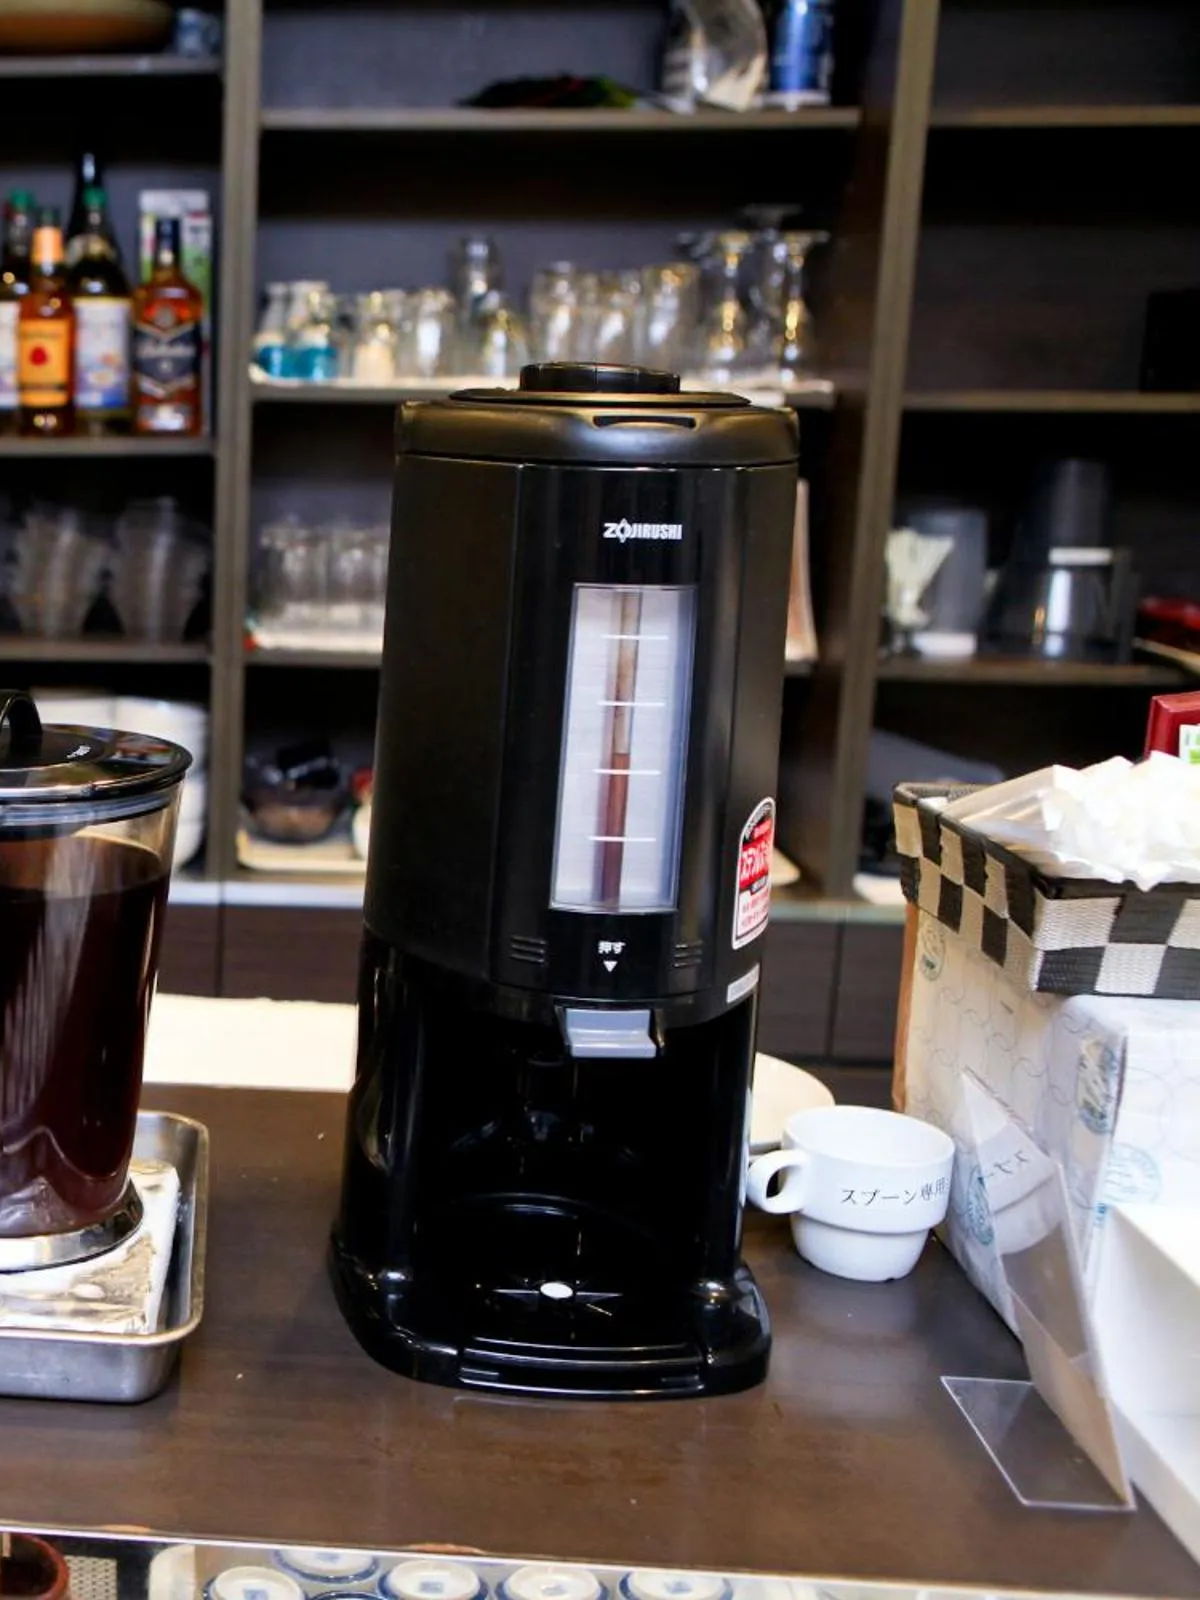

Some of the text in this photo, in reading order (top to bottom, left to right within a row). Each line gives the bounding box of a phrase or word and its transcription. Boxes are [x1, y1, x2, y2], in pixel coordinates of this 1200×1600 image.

[603, 518, 683, 543] ZOJIRUSHI
[840, 1177, 950, 1206] スプーン専用
